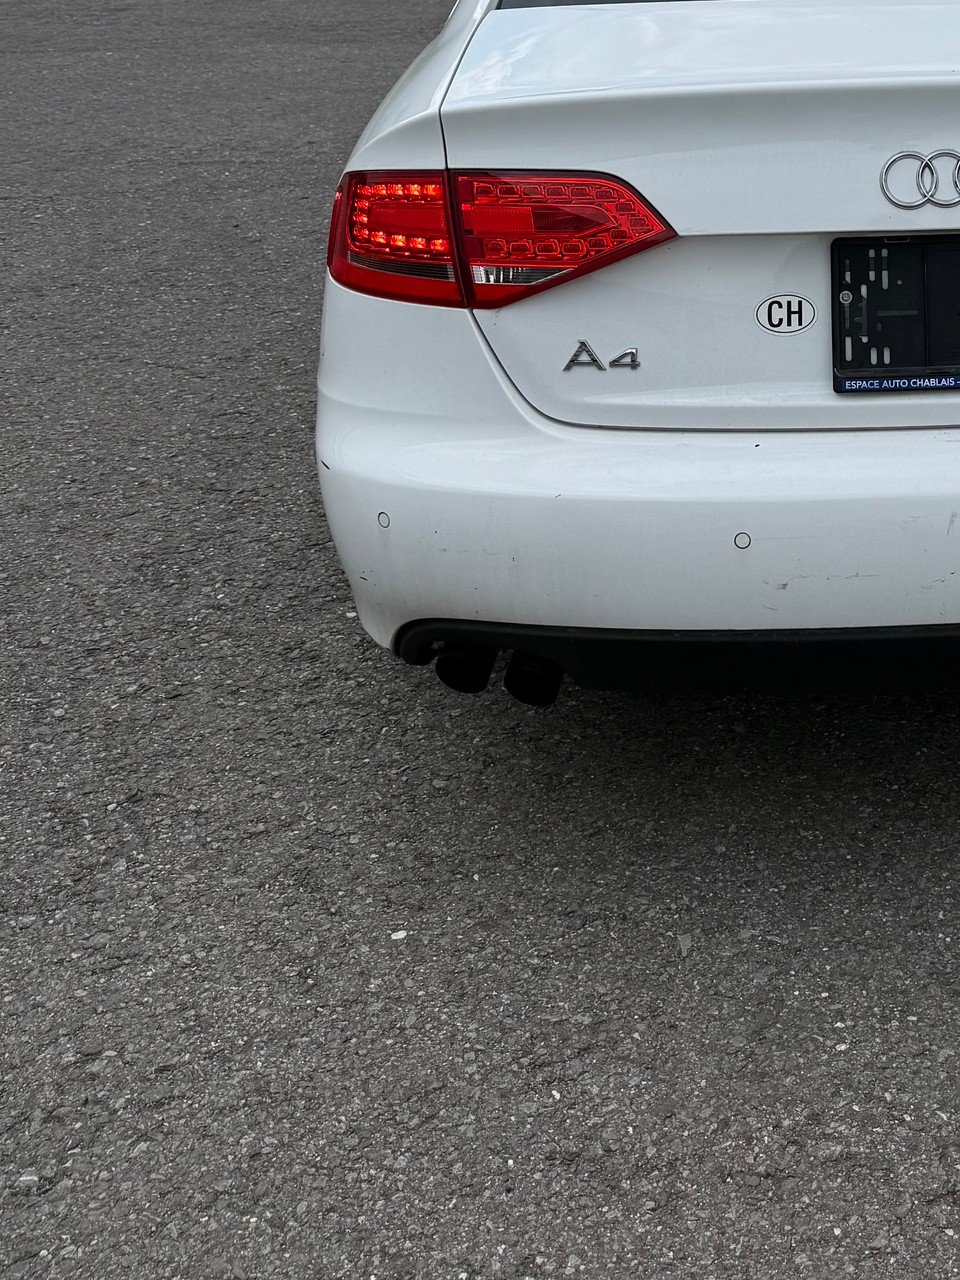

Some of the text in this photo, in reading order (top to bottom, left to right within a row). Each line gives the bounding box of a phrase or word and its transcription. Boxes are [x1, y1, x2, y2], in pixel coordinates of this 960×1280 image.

[767, 300, 803, 328] CH
[562, 338, 641, 372] A4
[845, 380, 880, 389] ESPACE
[882, 379, 908, 388] AUTO
[910, 378, 955, 387] CHABLAIS
